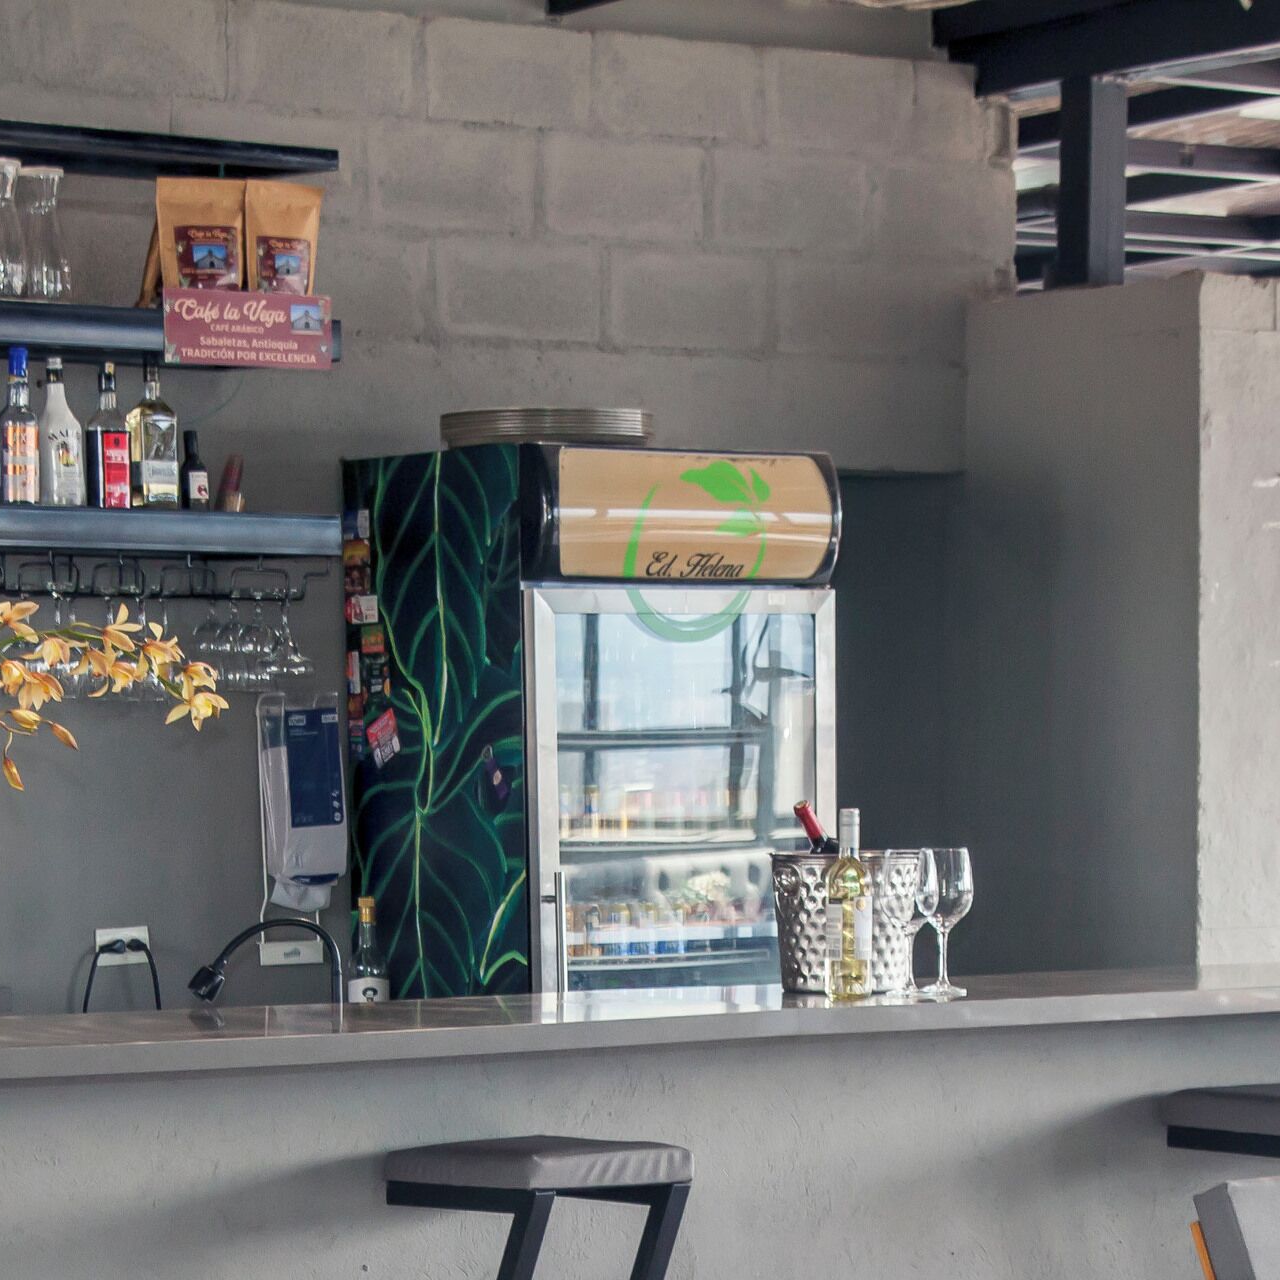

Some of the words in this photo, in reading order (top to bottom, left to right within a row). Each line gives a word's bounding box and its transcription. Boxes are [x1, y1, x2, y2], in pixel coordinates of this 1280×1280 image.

[174, 298, 220, 323] Café
[223, 302, 240, 321] la
[243, 300, 287, 328] Vega
[181, 347, 234, 360] TRADICIÓN
[237, 350, 257, 361] POR
[259, 352, 316, 364] EXCELENCIA
[251, 339, 298, 352] Antioquia
[645, 551, 678, 577] Ed.
[680, 552, 744, 578] Helena
